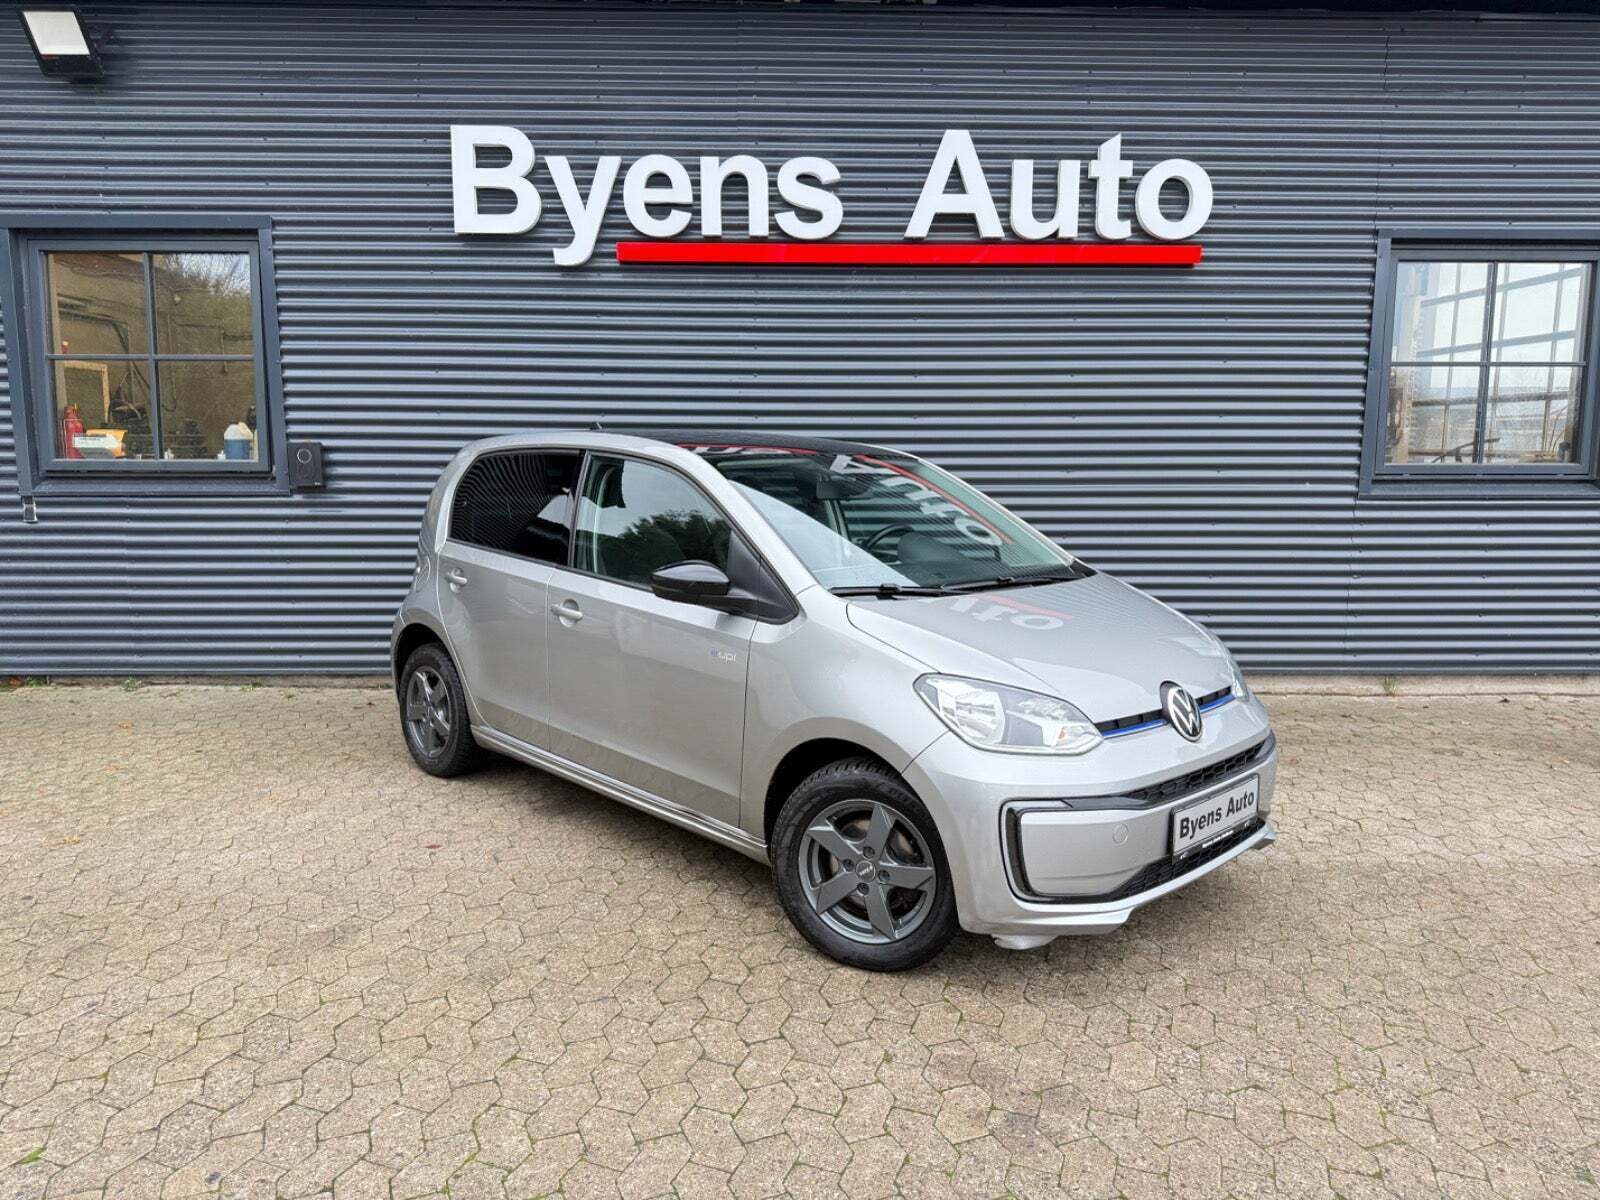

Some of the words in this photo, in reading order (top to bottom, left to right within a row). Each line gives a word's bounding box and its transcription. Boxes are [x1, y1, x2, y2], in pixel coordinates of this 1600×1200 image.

[450, 124, 844, 268] Byens
[904, 129, 1214, 241] Auto
[1180, 807, 1222, 839] Byens
[1226, 791, 1255, 817] Auto
